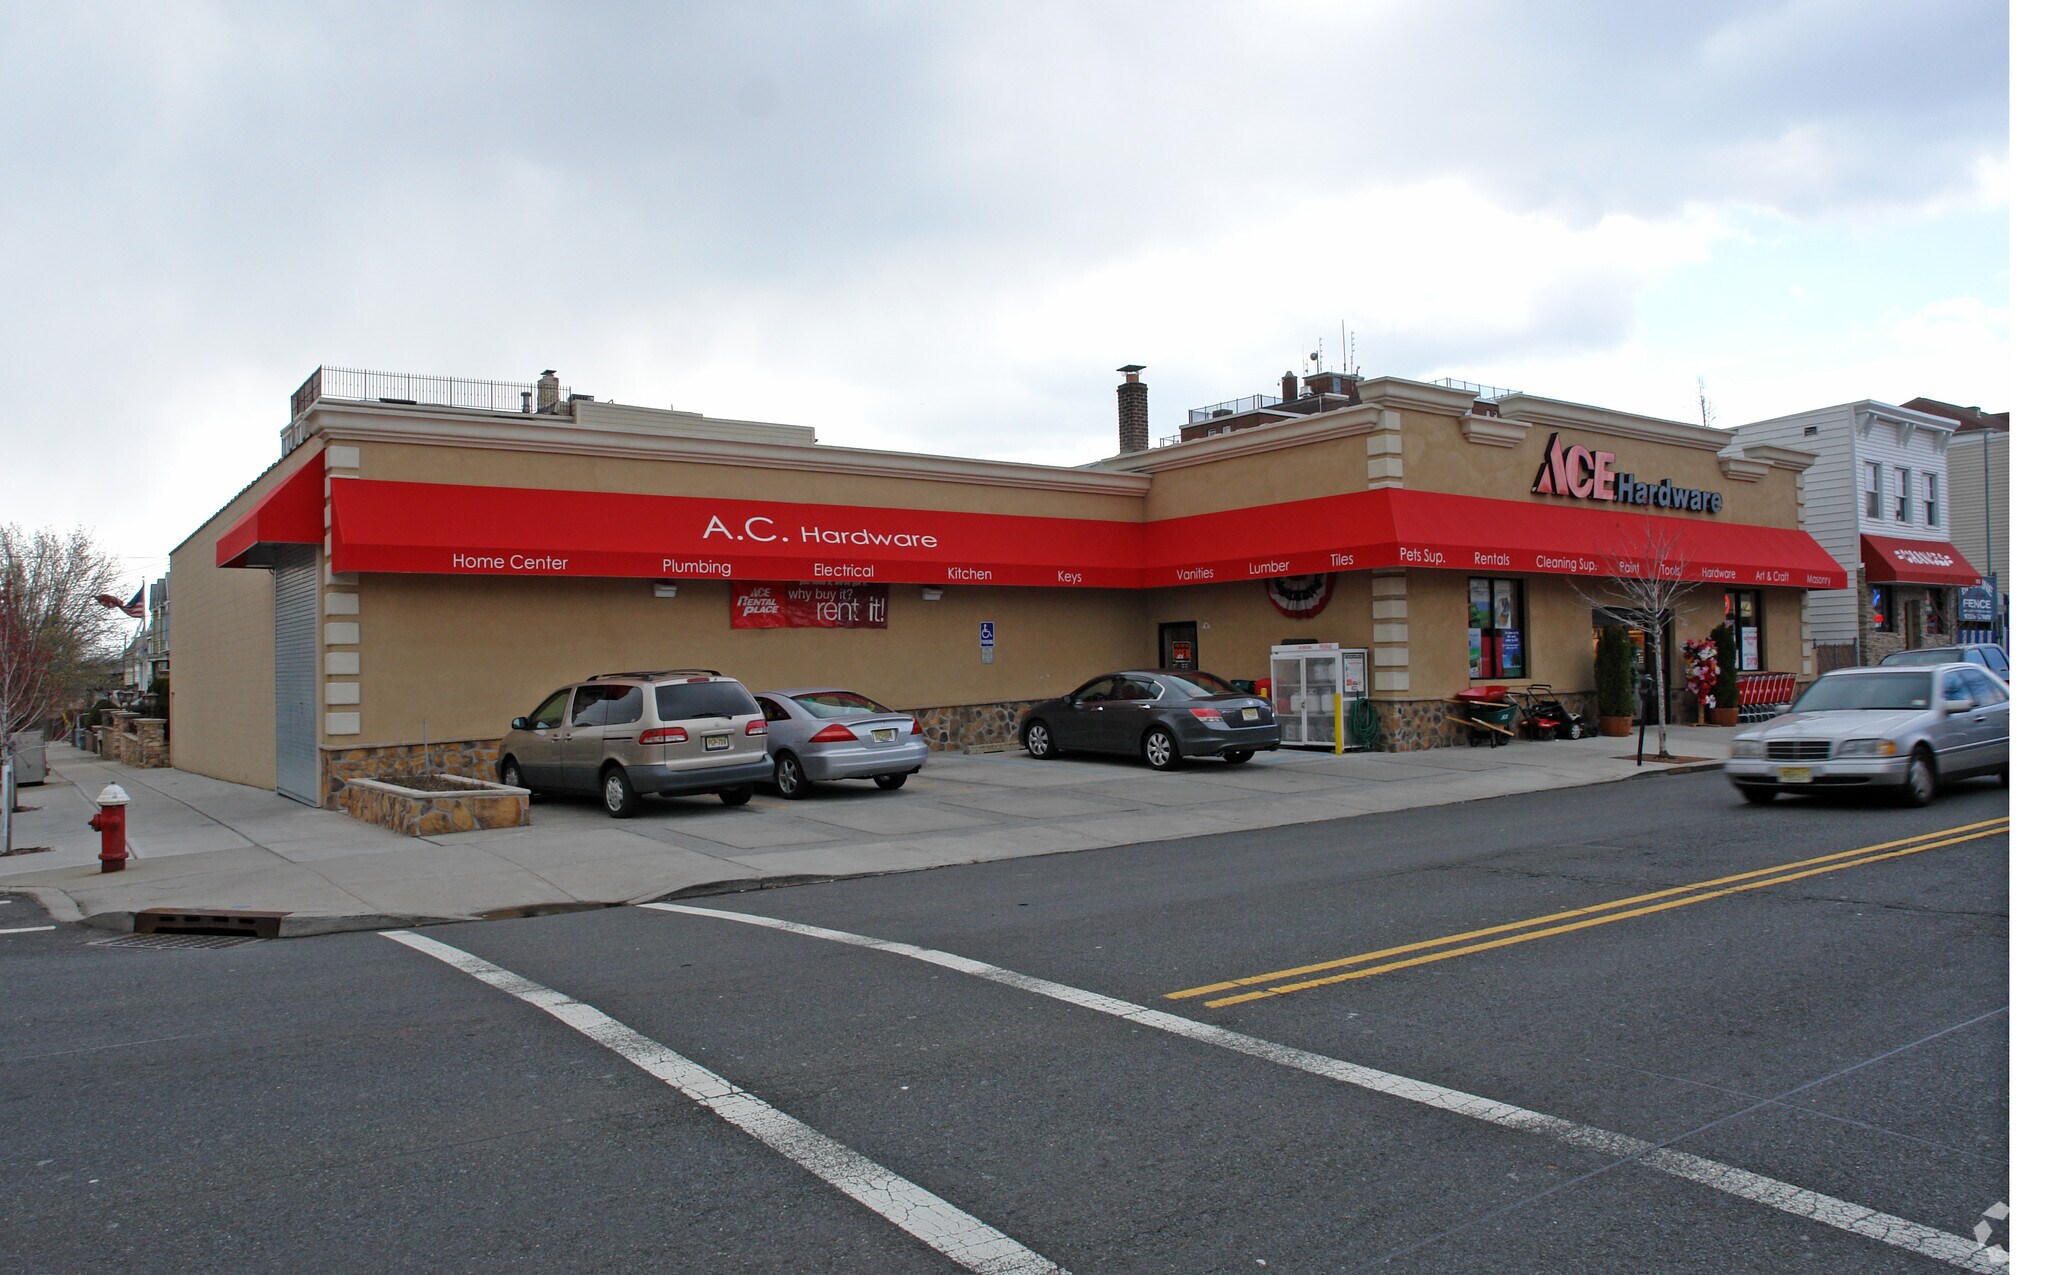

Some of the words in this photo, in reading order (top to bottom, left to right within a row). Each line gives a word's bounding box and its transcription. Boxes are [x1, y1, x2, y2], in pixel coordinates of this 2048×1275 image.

[1532, 432, 1616, 500] ACE
[1613, 471, 1723, 514] Hardware
[702, 514, 789, 543] A.C.
[801, 525, 938, 548] Hardware
[453, 553, 505, 569] Home
[509, 554, 569, 571] Center
[1330, 553, 1354, 568] Tiles
[1400, 547, 1422, 563] Pets
[1423, 548, 1446, 566] Sup.
[1474, 551, 1510, 567] Rentals
[1536, 555, 1577, 573] Cleaning
[1578, 557, 1598, 573] Sup.
[663, 558, 732, 578] Plumbing
[814, 563, 875, 579] Electrical
[947, 566, 993, 581] Kitchen
[1176, 566, 1215, 582] Vanities
[1249, 560, 1290, 576] Lumber
[1619, 561, 1640, 574] Paint
[1660, 564, 1681, 576] Tools
[1701, 567, 1736, 580] Hardware
[1057, 570, 1083, 585] Keys
[1755, 571, 1766, 582] Art
[1766, 571, 1772, 582] &
[1772, 571, 1790, 583] Craft
[1806, 574, 1832, 587] Masonry
[750, 587, 771, 597] ACE
[788, 588, 812, 601] why
[815, 588, 837, 602] buy
[839, 588, 853, 599] it?
[737, 596, 777, 606] RENTAL
[1962, 598, 1992, 609] FENCE
[743, 605, 779, 617] PLACE
[816, 598, 860, 621] rent
[869, 596, 885, 622] it!
